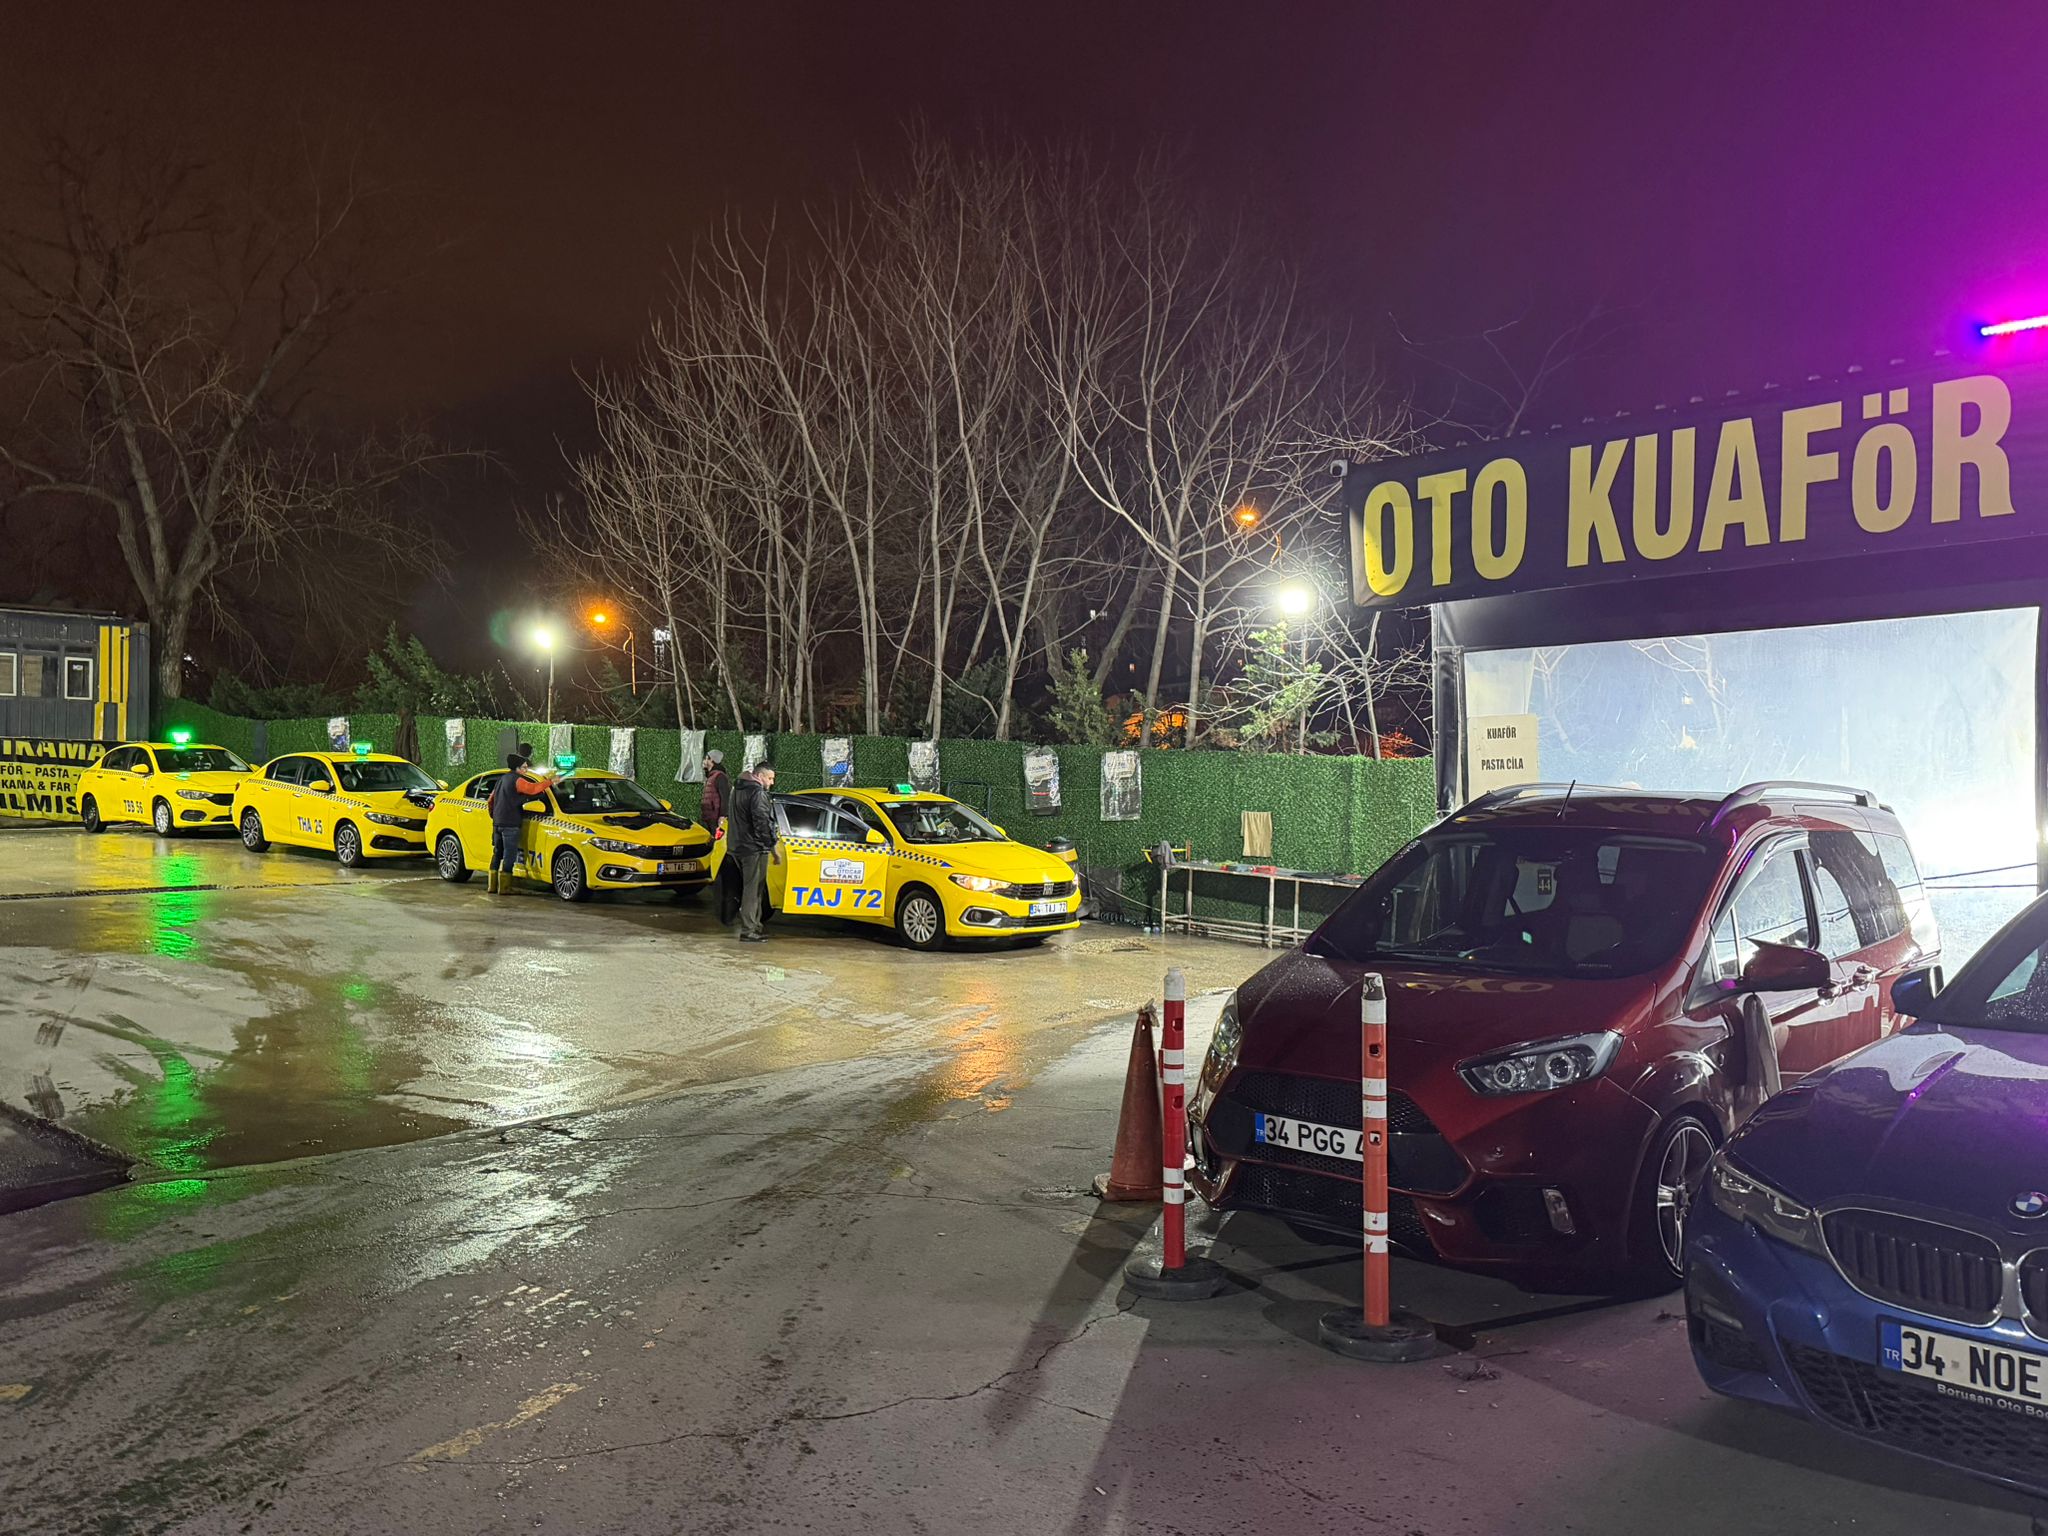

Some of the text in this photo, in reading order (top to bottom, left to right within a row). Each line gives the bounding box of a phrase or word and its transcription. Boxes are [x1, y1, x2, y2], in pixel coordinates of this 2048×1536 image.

[1363, 457, 1528, 597] OTO
[1486, 725, 1517, 740] KUAFÖR
[35, 767, 69, 779] PASTA
[1481, 756, 1524, 771] PASTA CİLA
[1, 780, 34, 790] KAMA
[50, 782, 71, 792] FAR
[791, 886, 883, 909] TAJ 72
[1265, 1117, 1290, 1145] 34
[1298, 1124, 1345, 1154] PGG
[1885, 1331, 2042, 1399] TR 34 NOE
[1937, 1383, 1993, 1406] Borusan
[1996, 1398, 2022, 1414] Oto
